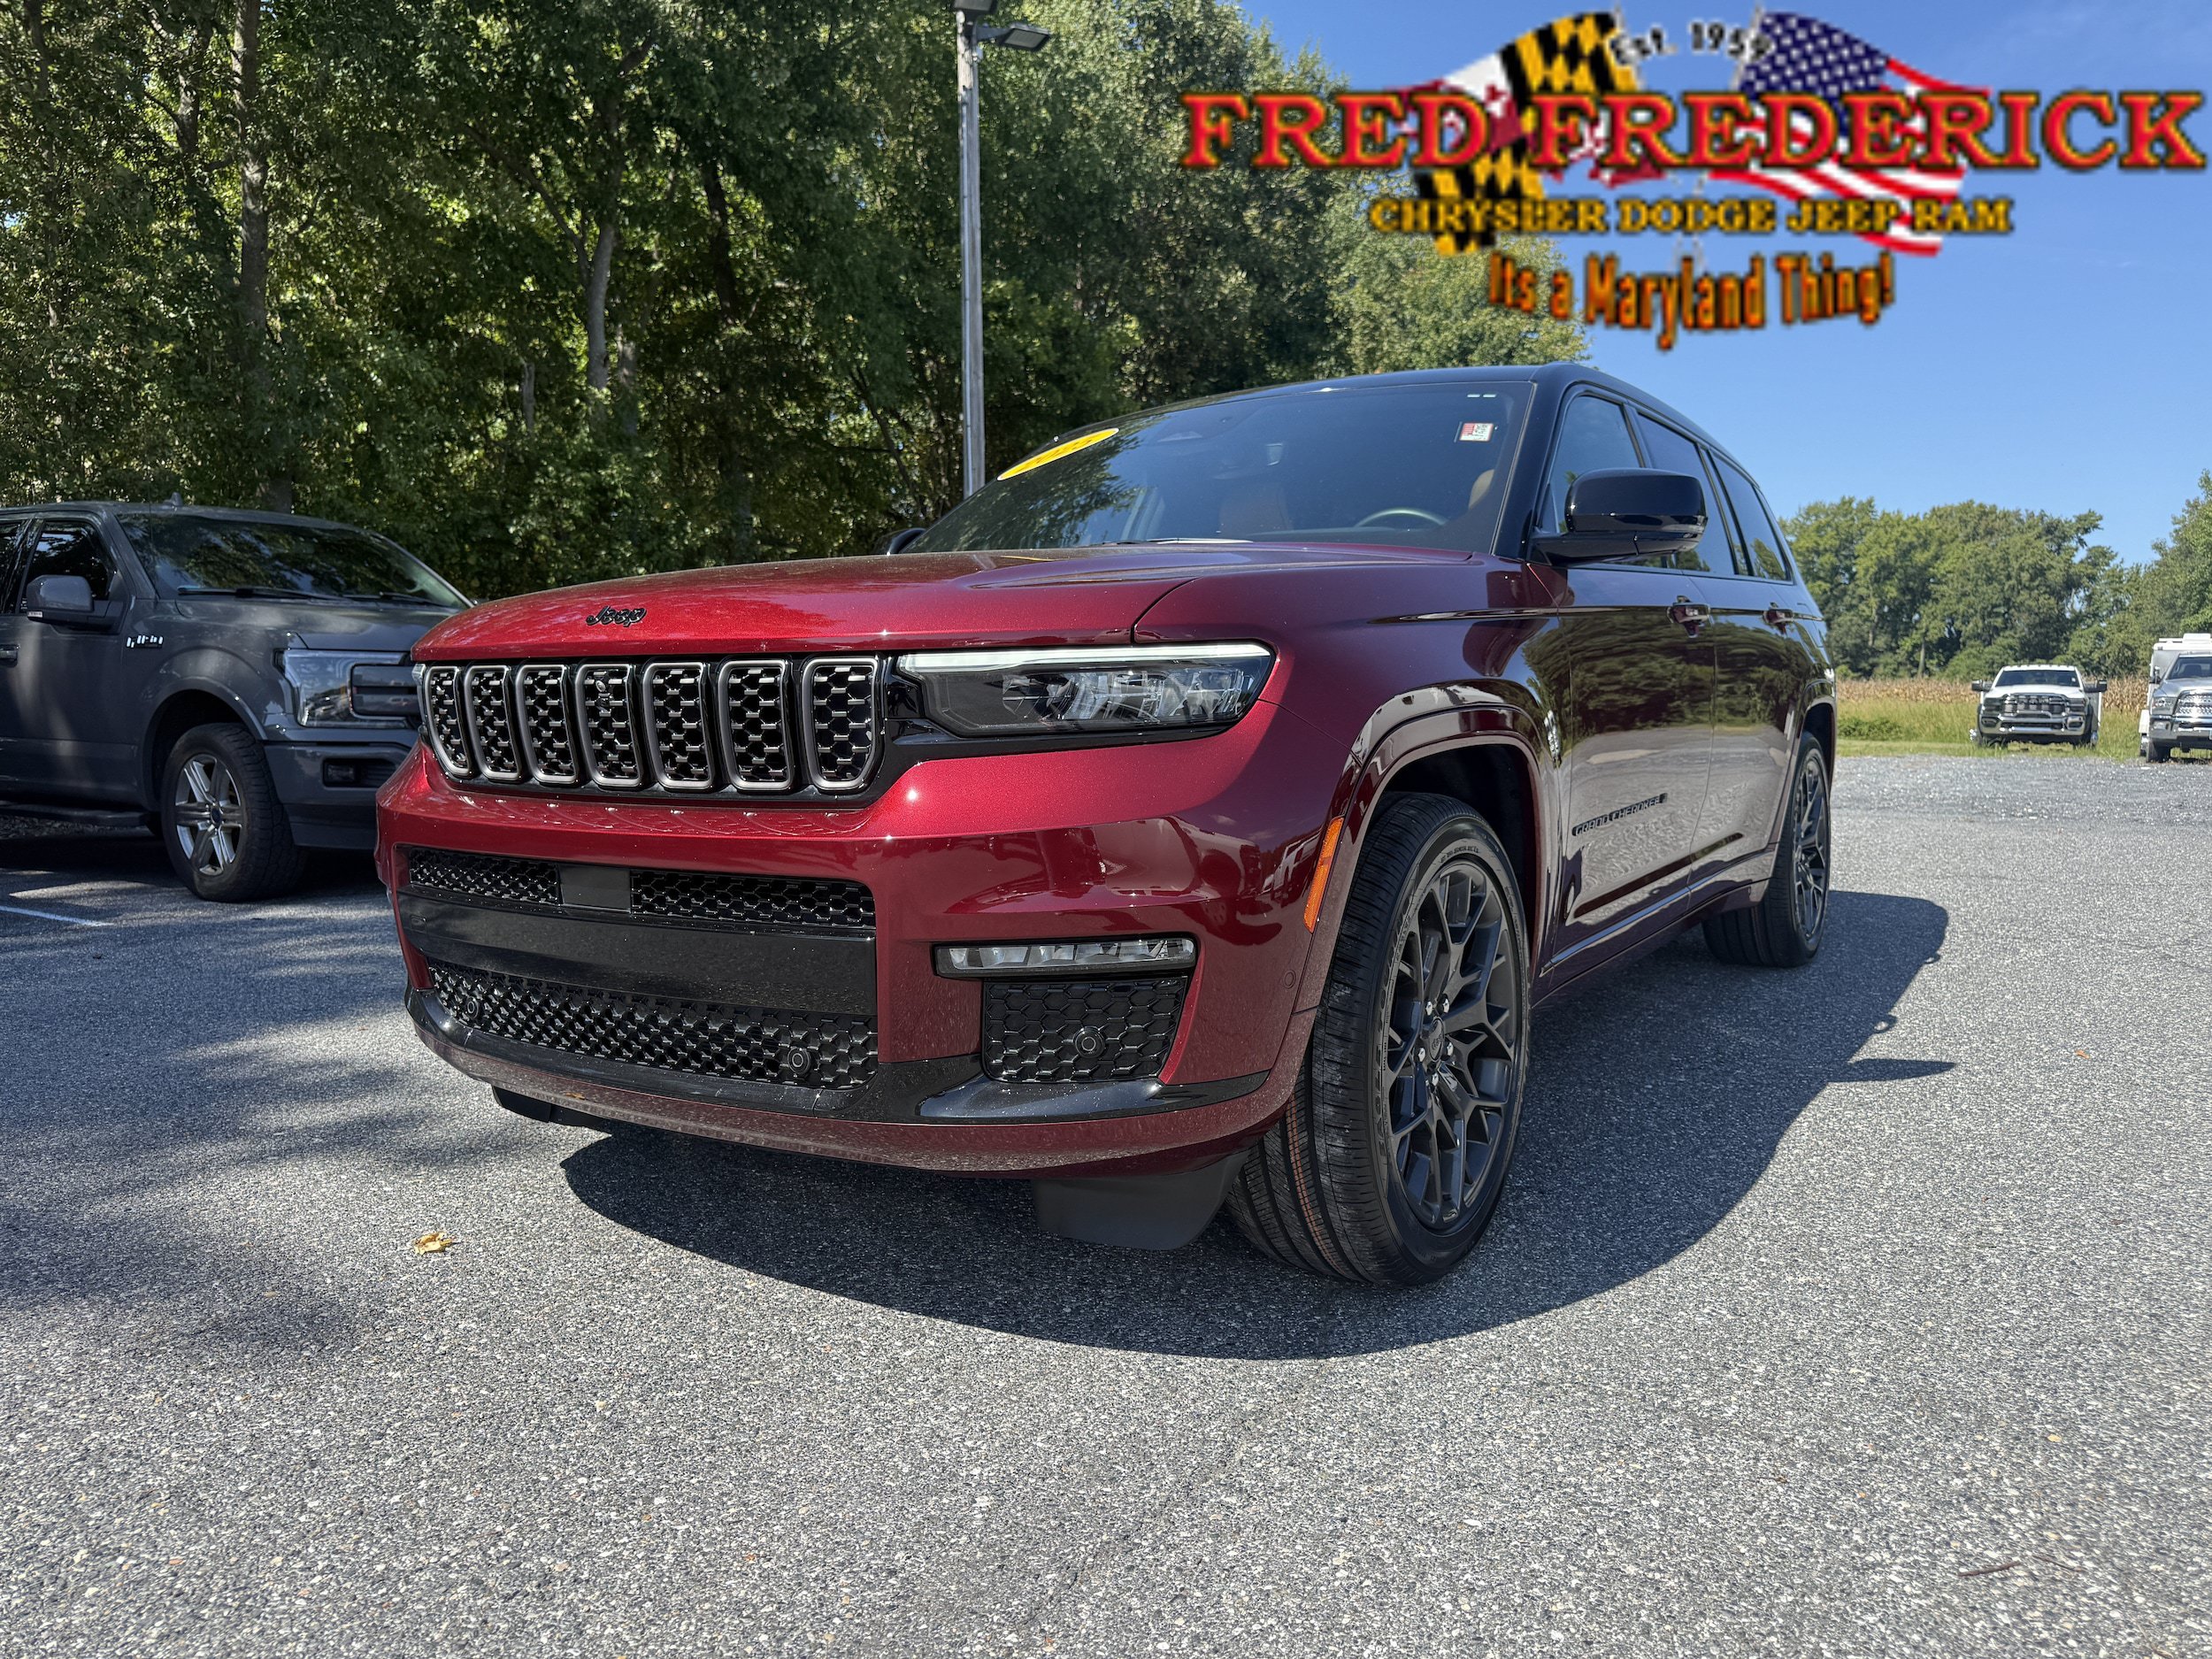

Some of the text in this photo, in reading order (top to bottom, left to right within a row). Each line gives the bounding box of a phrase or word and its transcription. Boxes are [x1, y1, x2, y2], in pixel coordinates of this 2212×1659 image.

[586, 605, 647, 627] Jeep
[1571, 814, 1609, 836] GRAND
[1609, 795, 1659, 821] CHEROKEE
